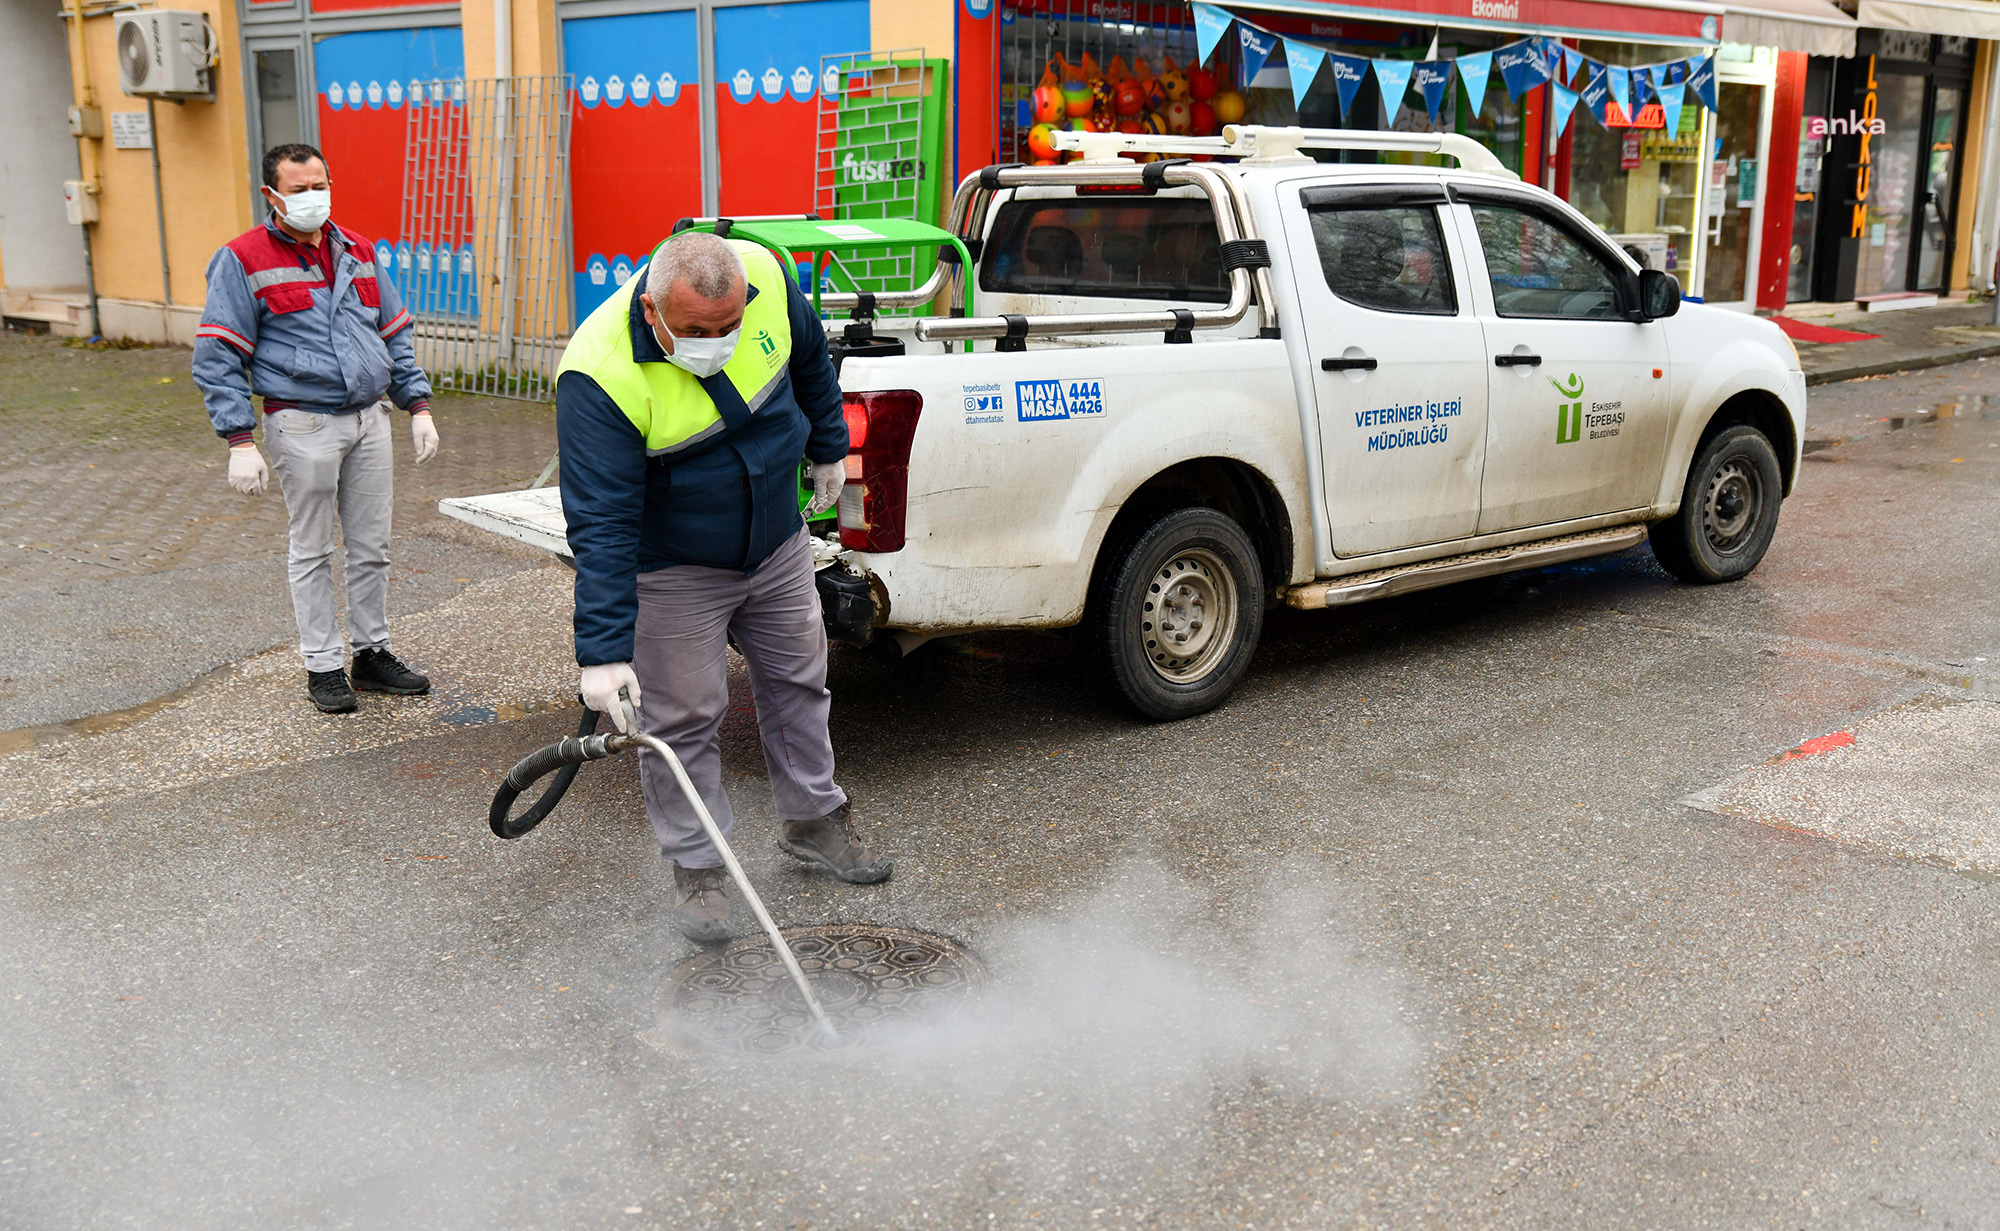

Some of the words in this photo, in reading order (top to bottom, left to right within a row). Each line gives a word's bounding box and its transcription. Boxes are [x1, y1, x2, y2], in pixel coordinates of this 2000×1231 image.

[1472, 0, 1518, 20] Ekomini
[1851, 54, 1878, 238] LOKUM
[1069, 382, 1101, 400] 444
[1021, 400, 1066, 418] MASA
[1070, 400, 1103, 414] 4426
[1355, 403, 1423, 427] VETERİNER
[1426, 396, 1462, 423] İŞLERİ
[1585, 412, 1625, 428] TEPEBAŞI
[1368, 424, 1448, 452] MÜDÜRLÜĞÜ
